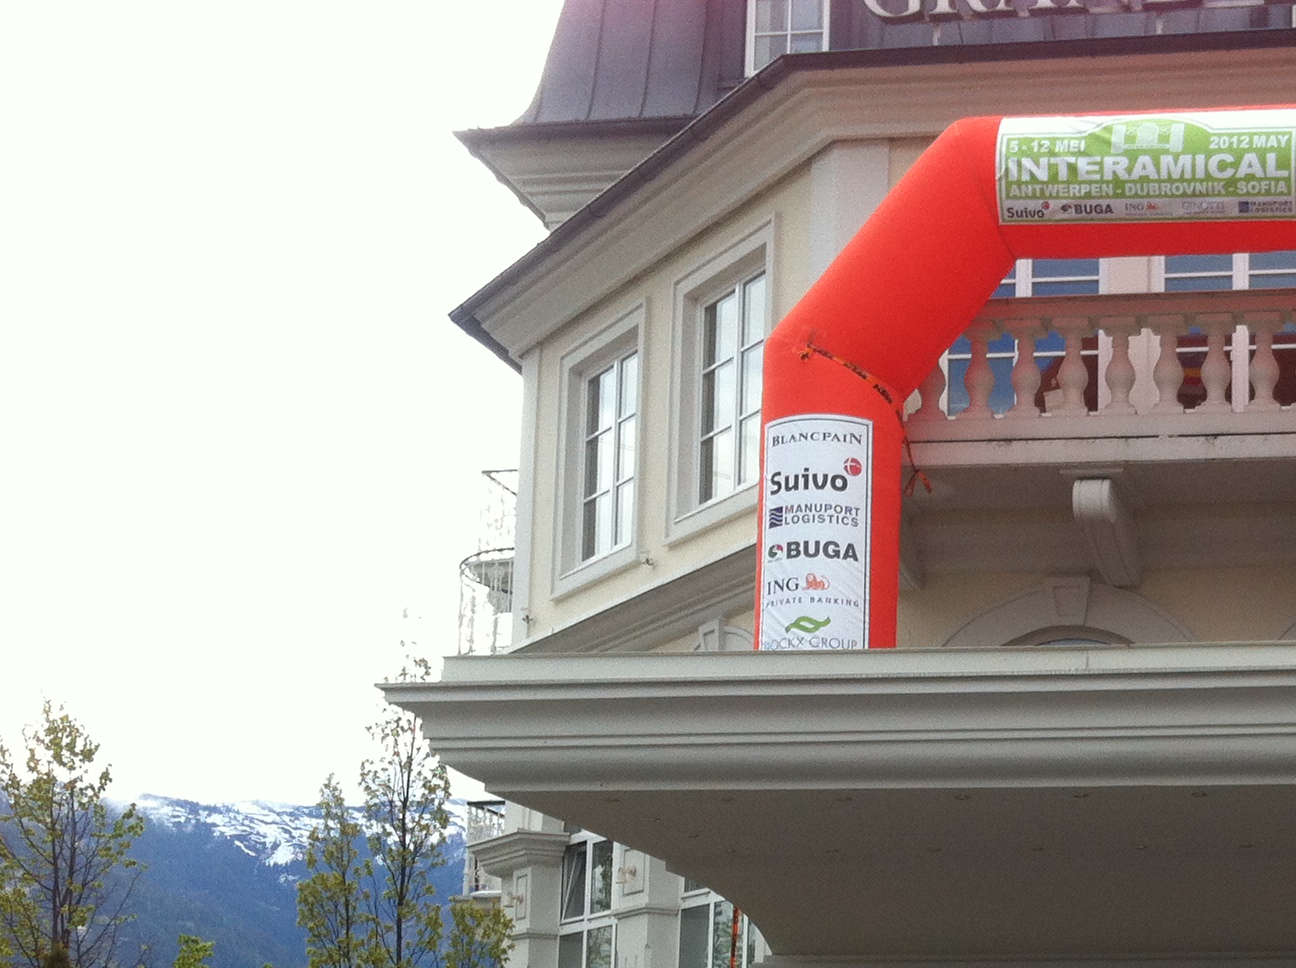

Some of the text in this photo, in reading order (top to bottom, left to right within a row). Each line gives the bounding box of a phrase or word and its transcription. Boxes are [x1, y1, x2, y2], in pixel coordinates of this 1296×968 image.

[1008, 140, 1019, 153] 5
[1031, 139, 1050, 153] 12
[1055, 138, 1086, 152] MEI
[1209, 134, 1290, 149] 2012 MAY
[1007, 153, 1289, 181] INTERAMICAL
[1009, 182, 1114, 198] ANTWERPEN
[1125, 181, 1226, 196] DUBROVNIK
[1237, 180, 1288, 194] SOFIA
[1006, 206, 1045, 219] Suivo
[1074, 203, 1114, 215] BUGA
[771, 431, 863, 447] BLANCPAIN
[769, 467, 849, 496] Suivo
[784, 503, 861, 517] MANUPORT
[784, 513, 860, 527] LOGISTICS
[786, 540, 859, 562] BUGA
[766, 577, 800, 596] ING
[765, 596, 860, 608] PRIVATE BANKING
[808, 636, 858, 650] GROUP
